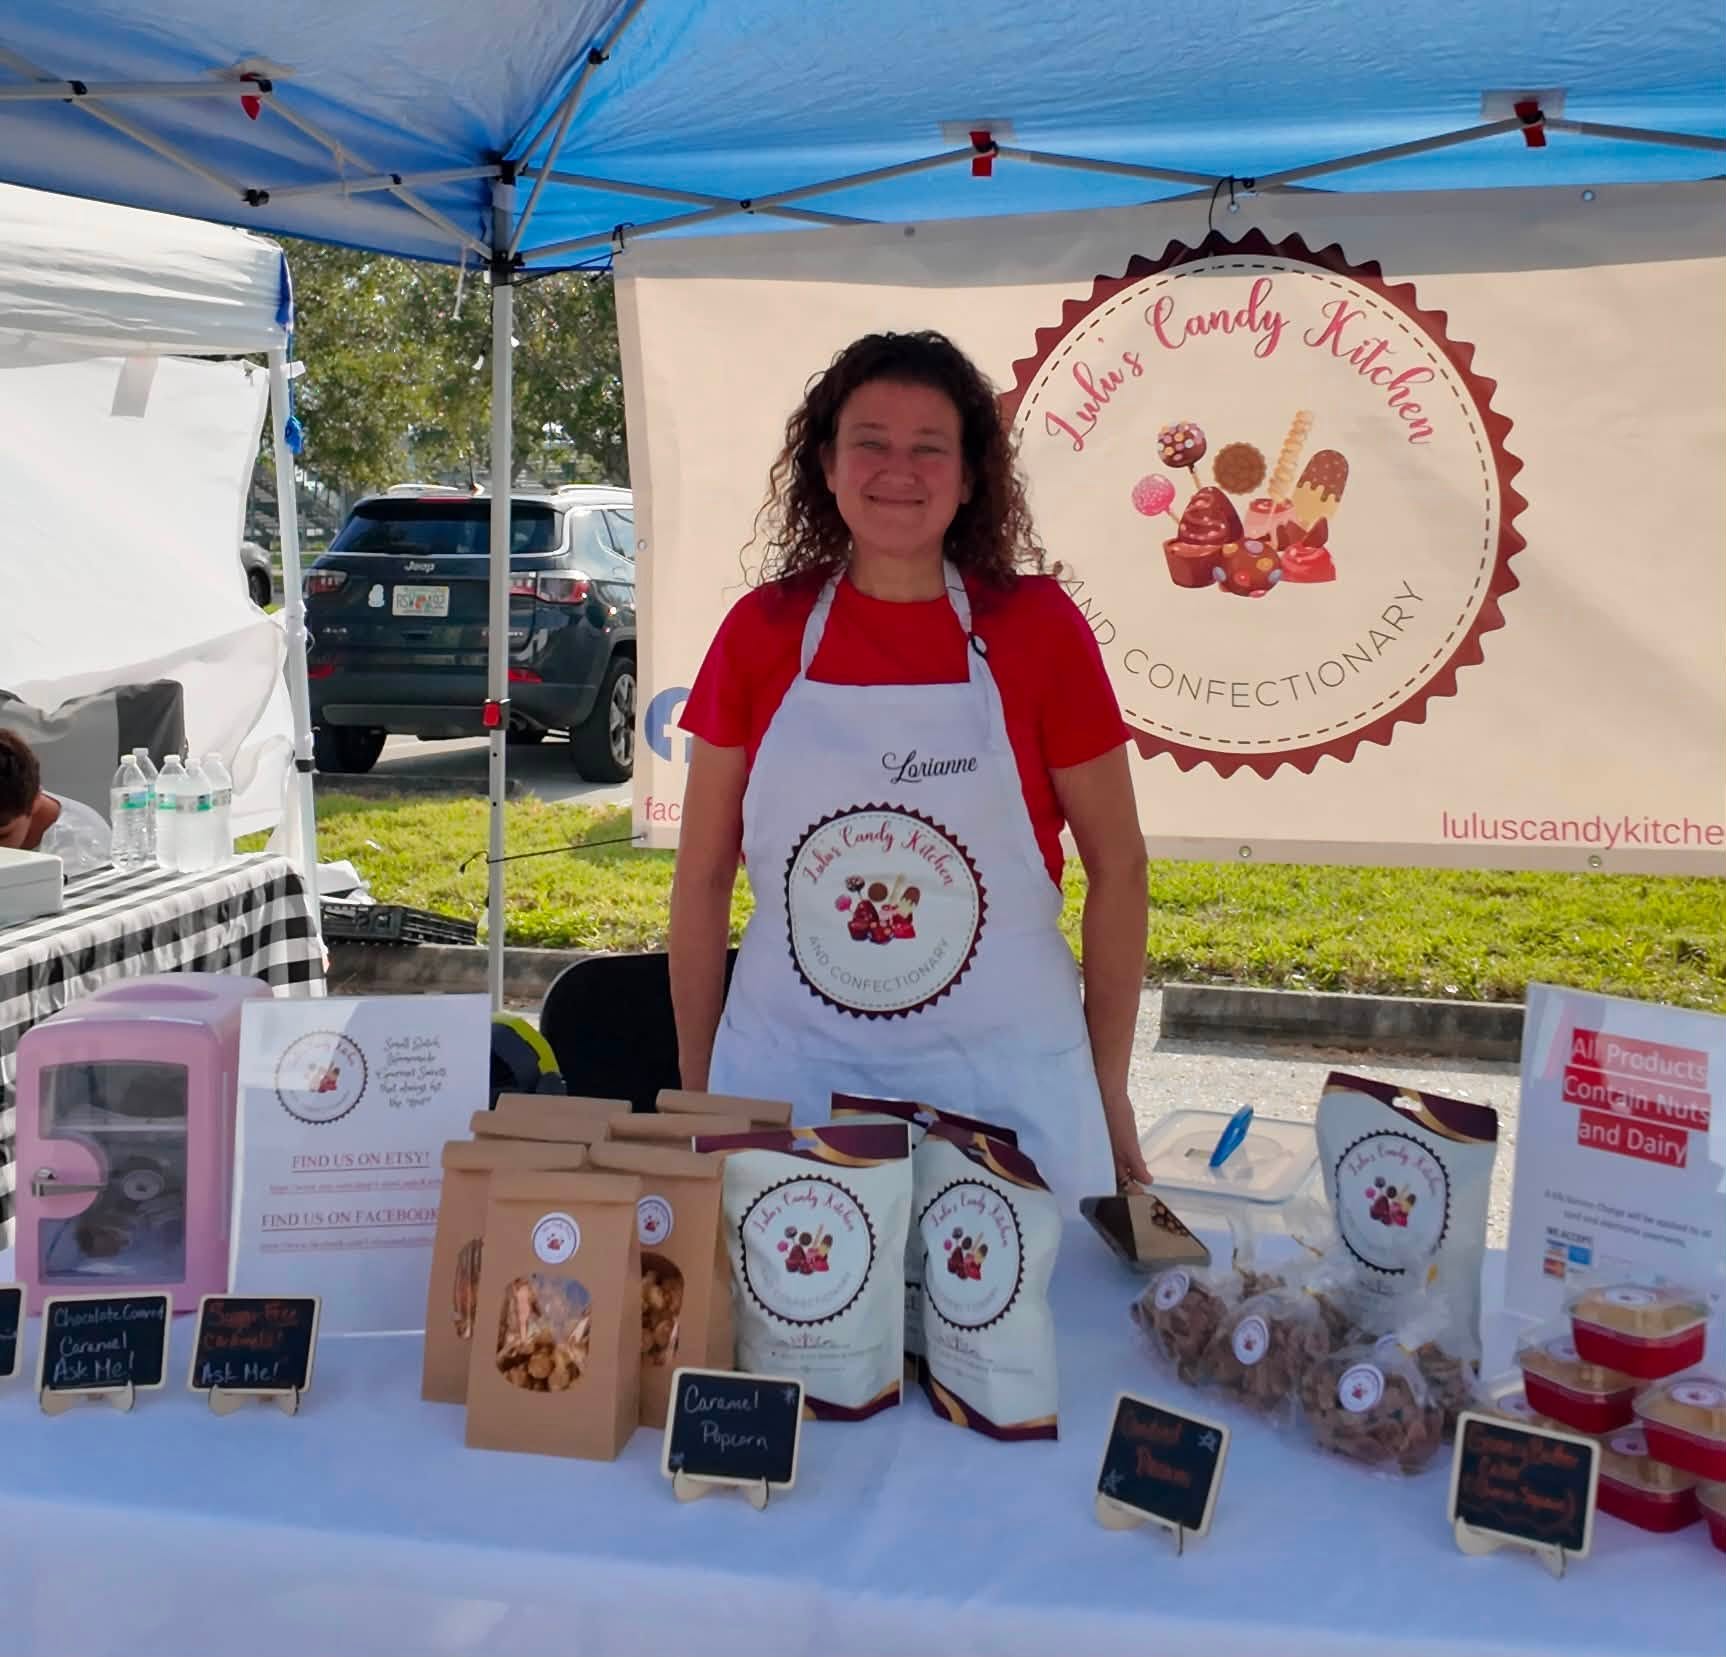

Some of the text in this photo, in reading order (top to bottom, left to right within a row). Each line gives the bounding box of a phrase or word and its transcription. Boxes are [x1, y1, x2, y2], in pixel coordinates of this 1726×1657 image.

[1045, 278, 1436, 451] Lulu's Candy Kitchen
[1123, 580, 1425, 709] CONFECTIONARY
[882, 750, 978, 784] Lorianne
[1442, 811, 1725, 850] luluscandykitche
[840, 820, 895, 852] Candy
[901, 829, 954, 886] Kitchen
[808, 935, 949, 993] AND CONFECTIONARY
[1573, 1037, 1706, 1082] All Products
[1564, 1075, 1711, 1124] Contain Nuts
[292, 1150, 430, 1169] FIND US ON ETSY!
[1579, 1123, 1688, 1165] and Dairy
[262, 1212, 300, 1228] FIND
[303, 1211, 323, 1226] US
[327, 1210, 350, 1225] ON
[59, 1331, 127, 1357] Caramel
[53, 1349, 135, 1383] Ask Me!
[201, 1359, 280, 1385] Ask Me!
[684, 1384, 759, 1413] Caramel
[701, 1419, 769, 1454] Popcorn
